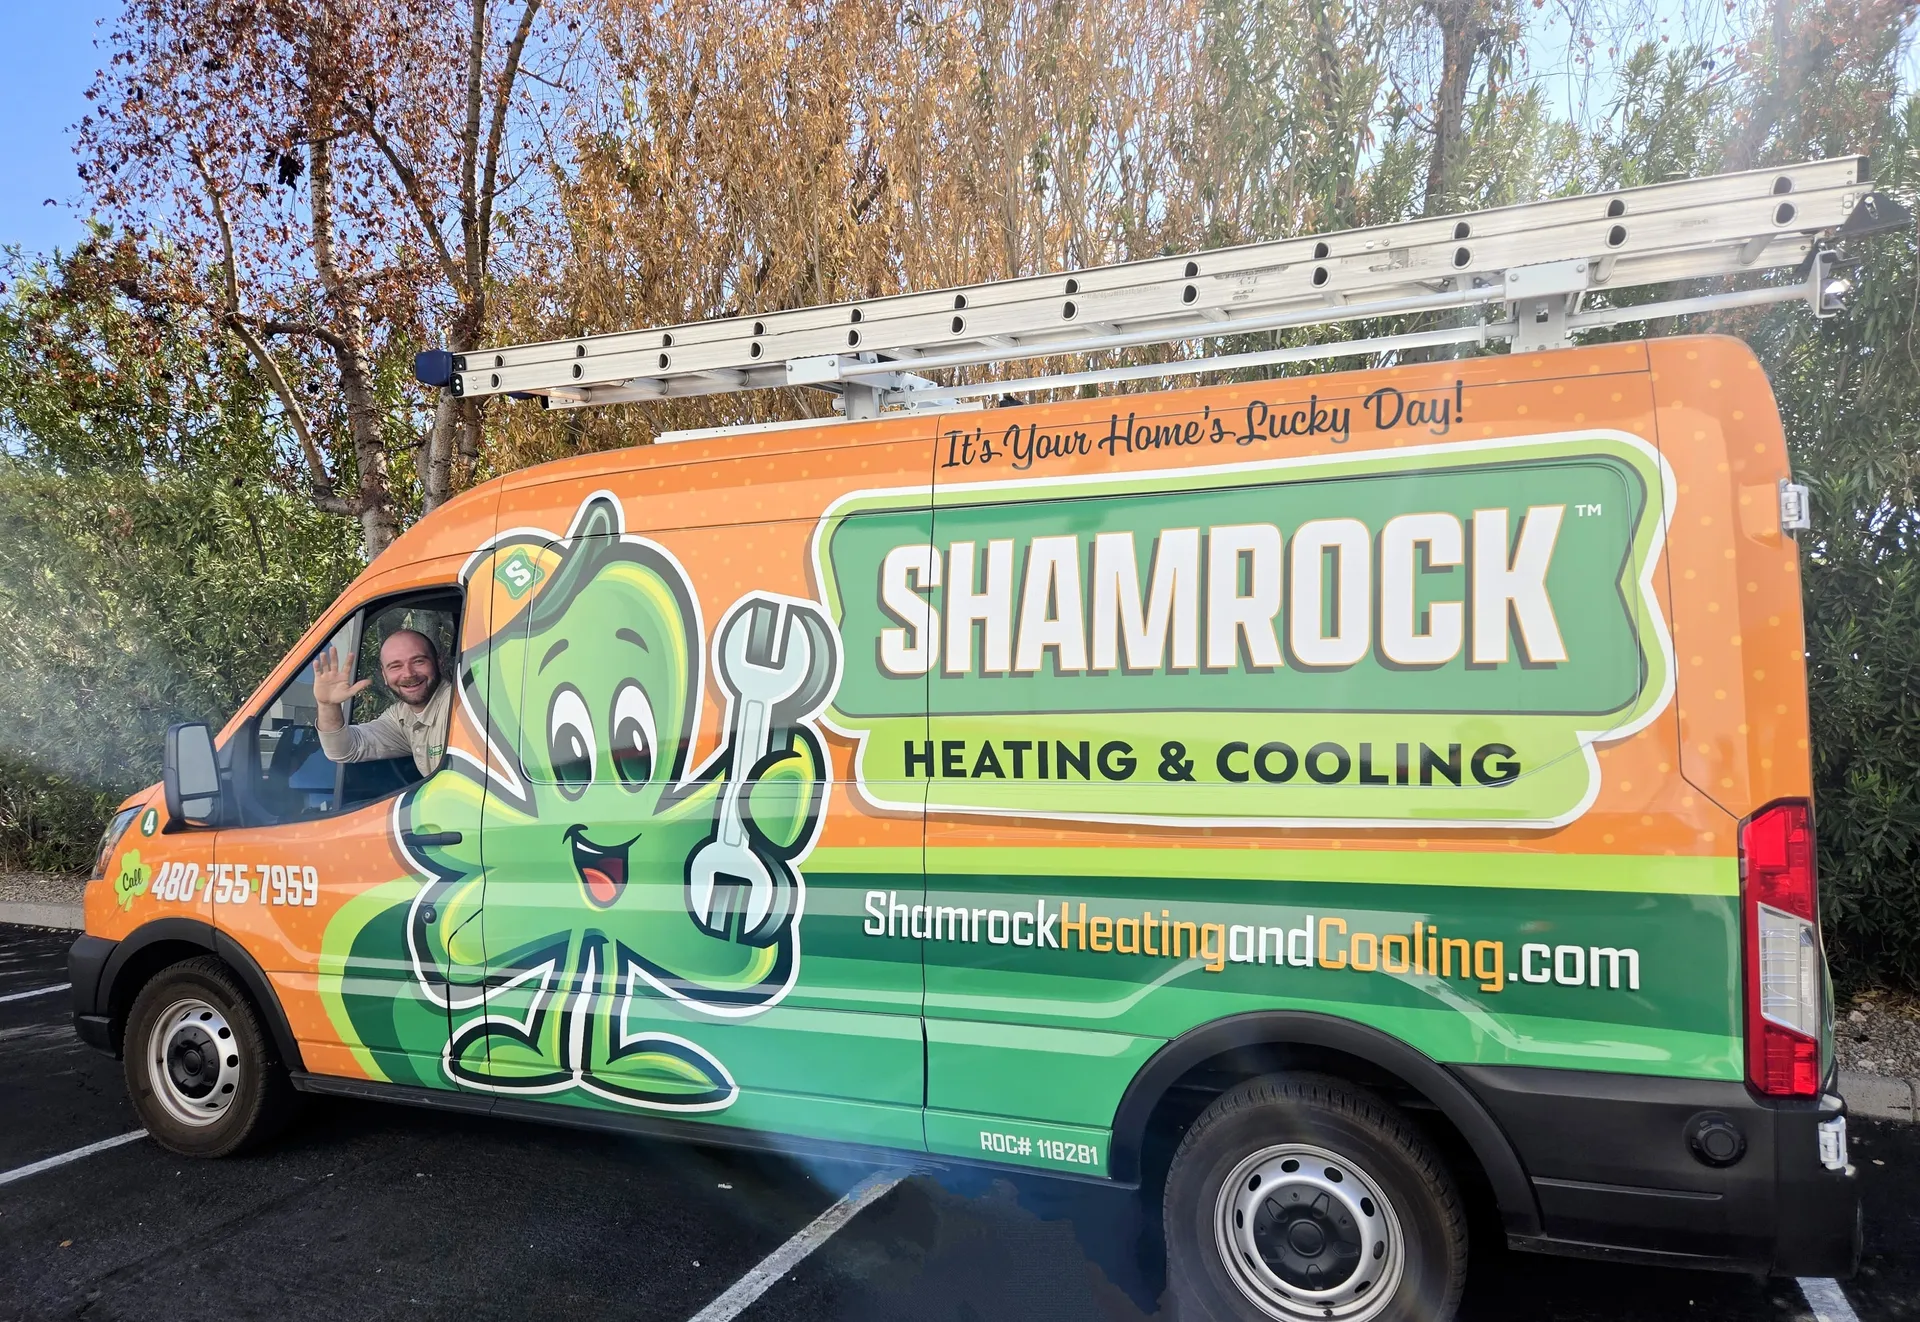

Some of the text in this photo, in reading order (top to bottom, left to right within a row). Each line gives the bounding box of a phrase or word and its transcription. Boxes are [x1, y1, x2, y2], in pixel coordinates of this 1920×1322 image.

[941, 379, 1464, 470] It's Your Home's Lucky Day!
[505, 560, 531, 587] S
[878, 503, 1570, 676] SHAMROCK
[903, 739, 1521, 788] HEATING & COOLING
[143, 810, 156, 834] 4
[122, 869, 144, 892] Call
[863, 890, 1640, 992] ShamrockHeatingandCooling.com
[979, 1131, 1099, 1166] ROC# 118281
